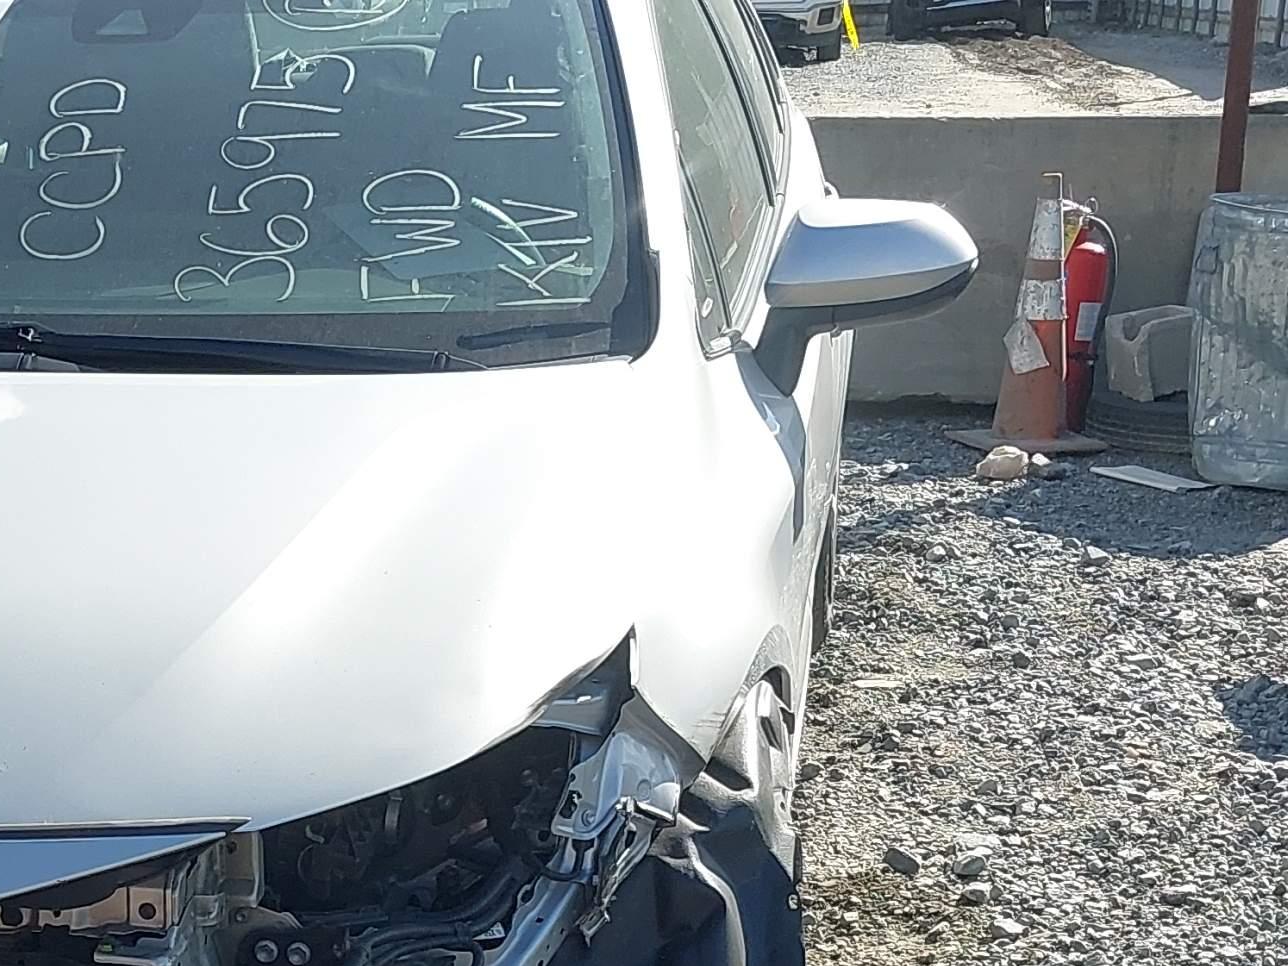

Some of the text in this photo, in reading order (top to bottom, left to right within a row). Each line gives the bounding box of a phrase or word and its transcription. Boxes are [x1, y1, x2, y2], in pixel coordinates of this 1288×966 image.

[19, 78, 126, 260] CCPD
[173, 52, 357, 303] 365975
[454, 54, 566, 140] MF
[356, 169, 462, 313] FWD
